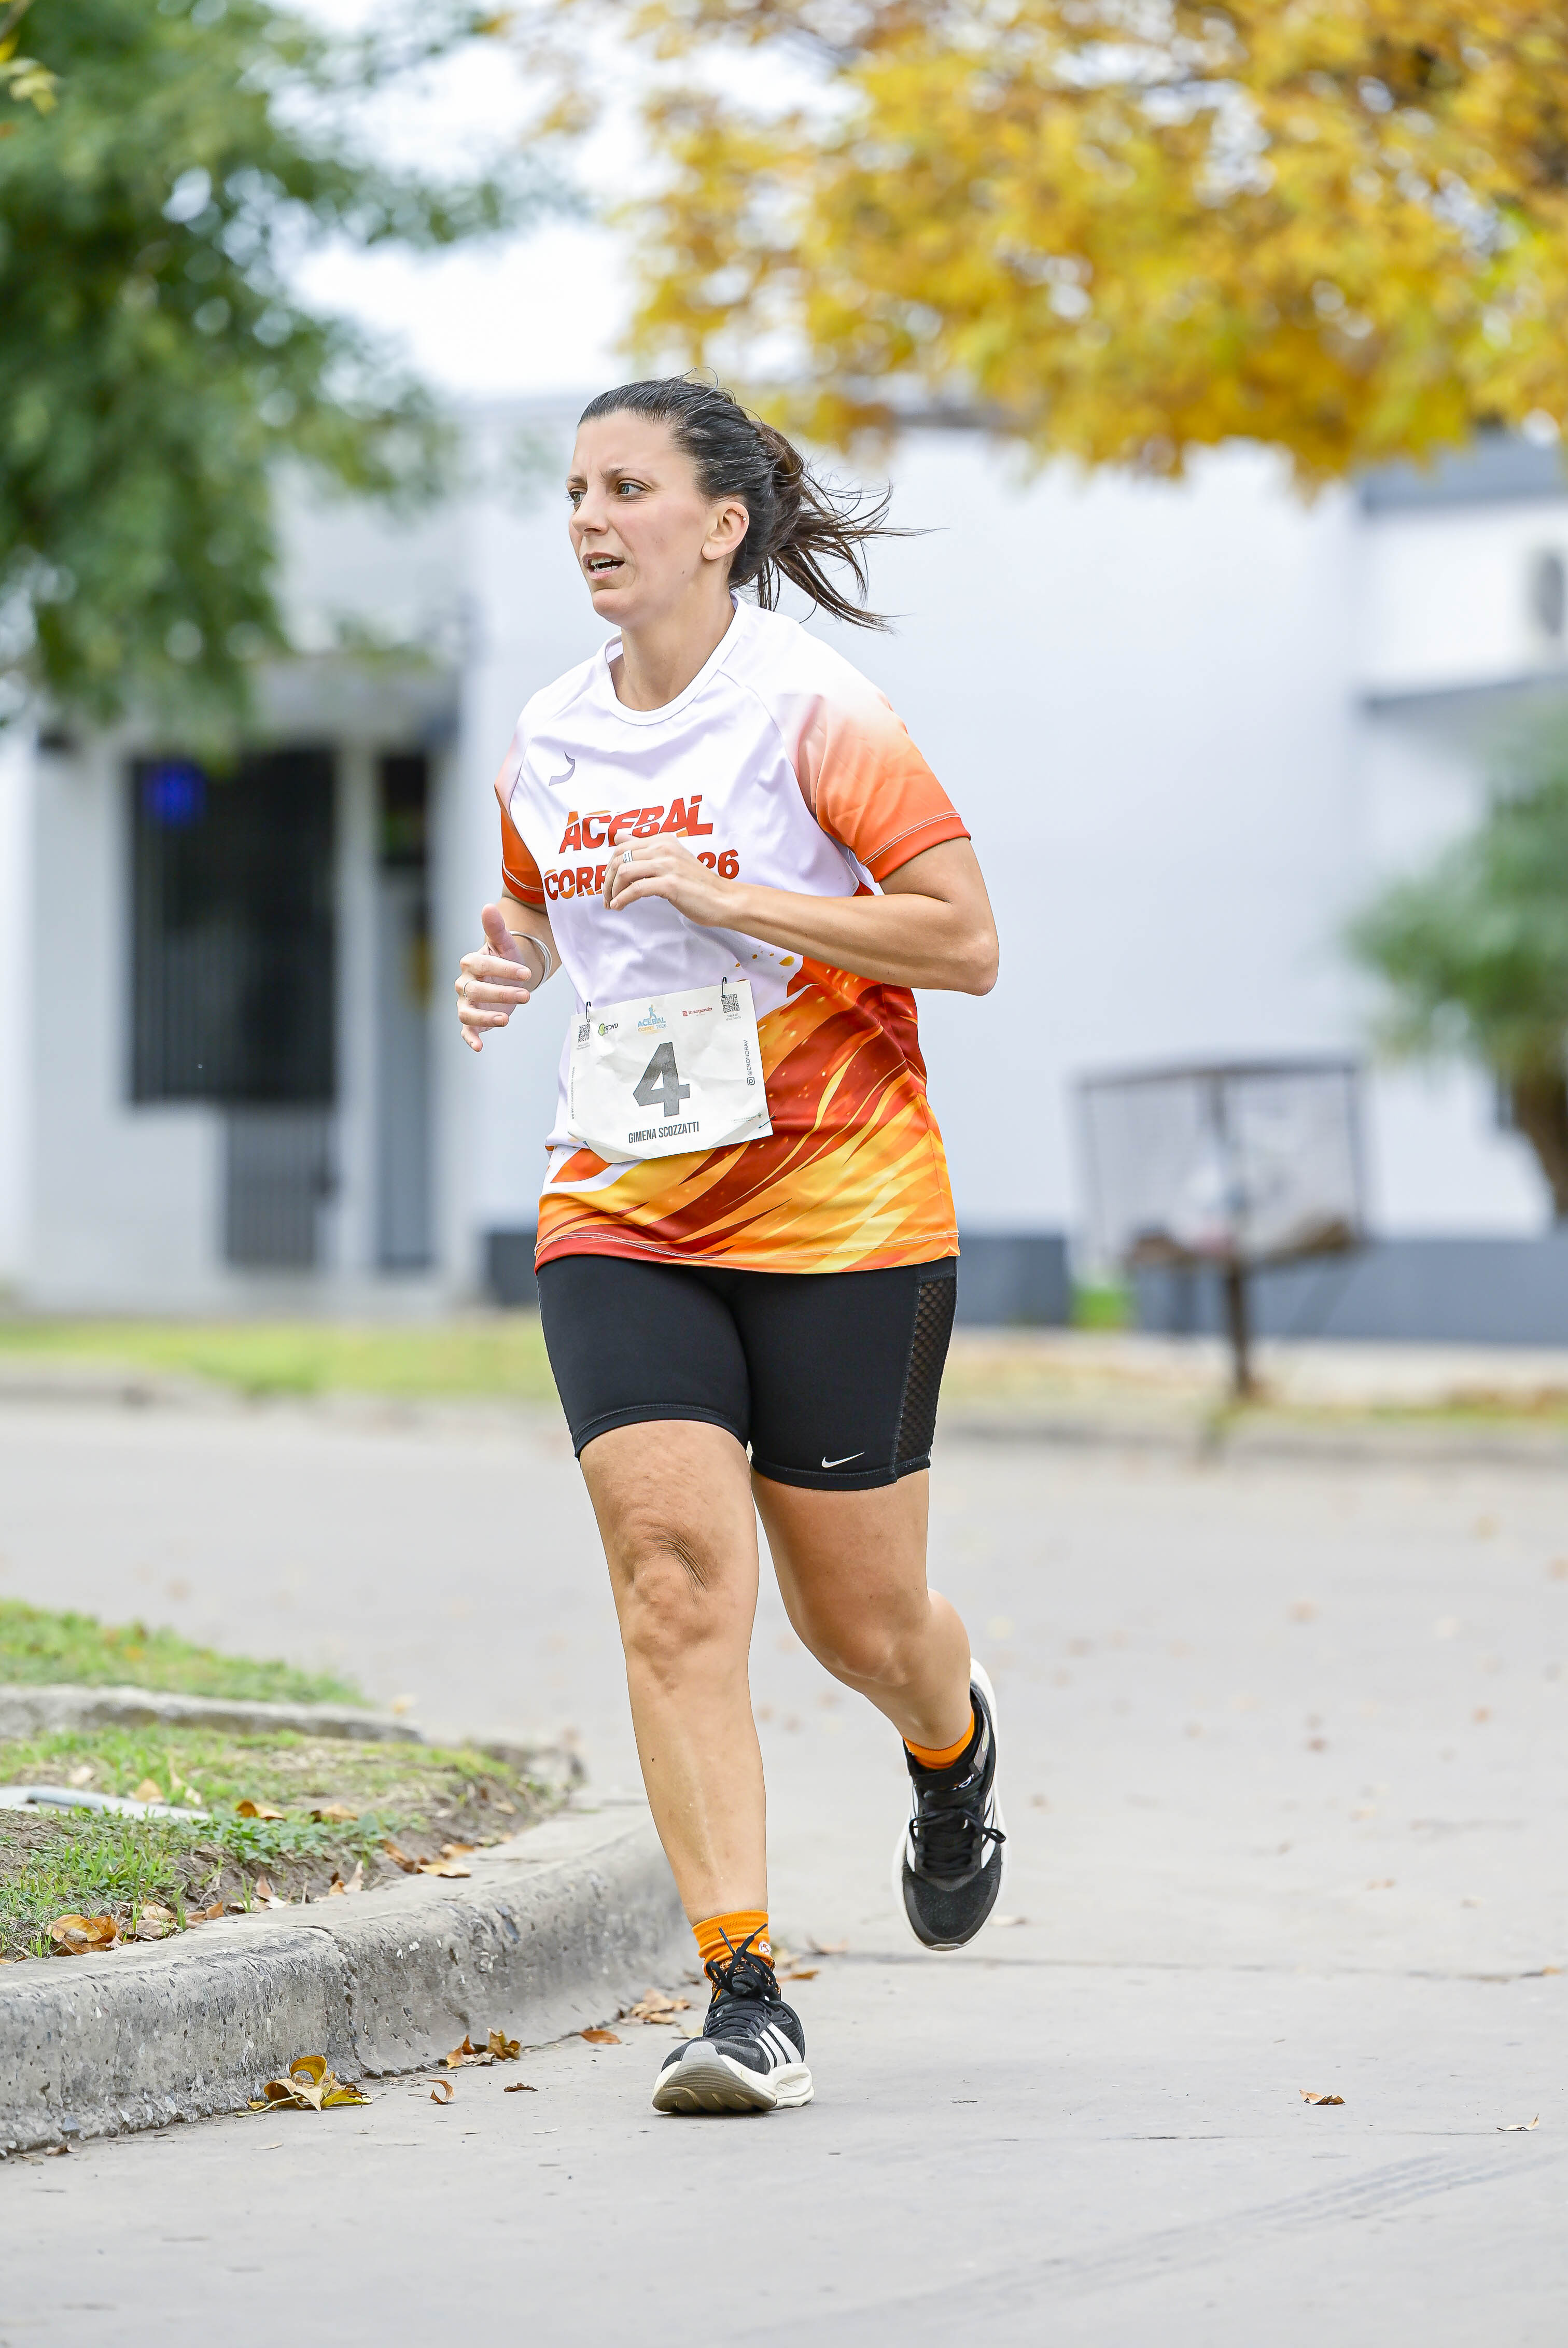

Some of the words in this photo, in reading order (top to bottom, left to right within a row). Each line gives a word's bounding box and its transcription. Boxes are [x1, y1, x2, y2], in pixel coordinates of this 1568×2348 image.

[544, 864, 607, 901] CORR
[697, 849, 739, 879] 26
[638, 1017, 666, 1027] ACEBAL
[743, 1040, 752, 1076] @CRONORAV
[633, 1042, 690, 1117] 4
[628, 1128, 657, 1143] GIMENA
[659, 1122, 699, 1138] SCOZZATTI
